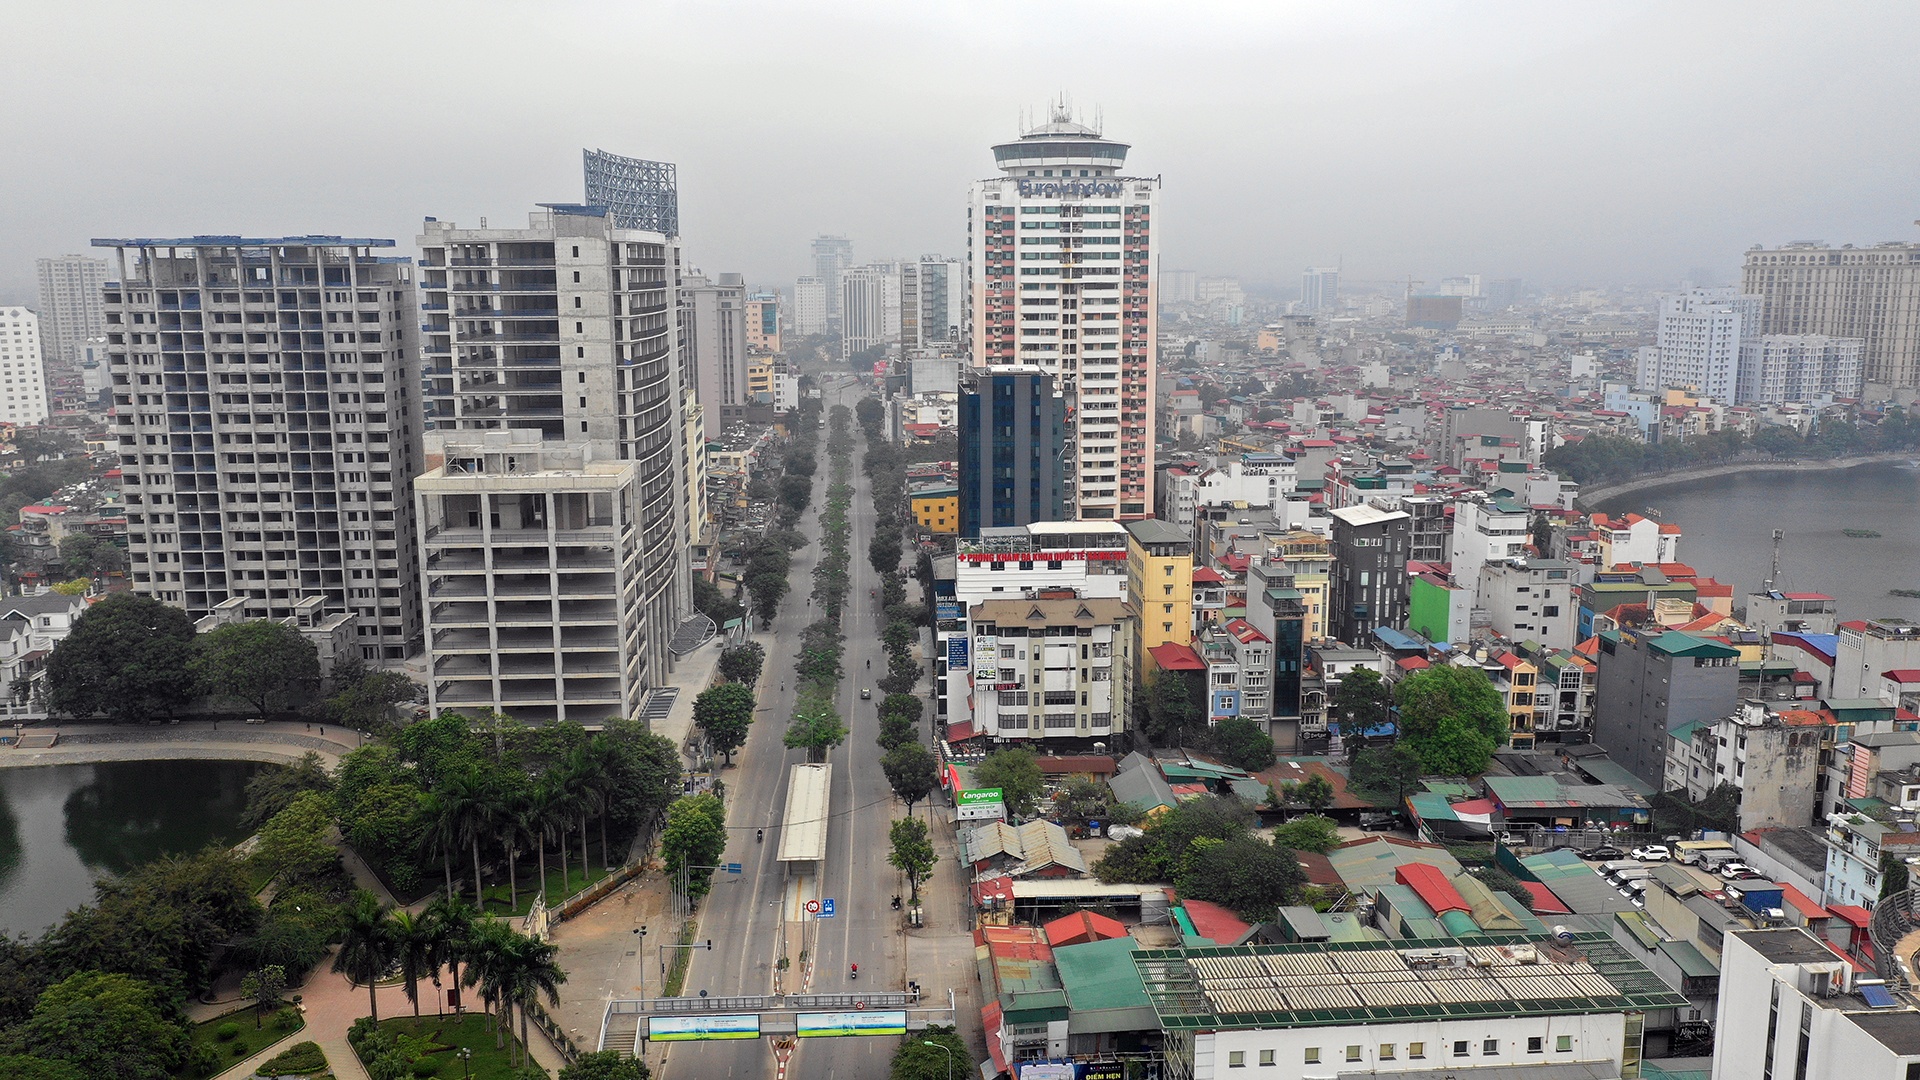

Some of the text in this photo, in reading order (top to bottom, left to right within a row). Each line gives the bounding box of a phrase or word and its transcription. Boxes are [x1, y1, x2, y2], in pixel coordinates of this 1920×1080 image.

[1020, 180, 1121, 196] Eurowindow
[967, 552, 994, 562] PHÒNG
[996, 552, 1021, 562] KHÁM
[1021, 552, 1031, 561] ĐA
[1033, 552, 1053, 561] KHOA
[1054, 549, 1075, 561] QUỐC
[1076, 549, 1086, 561] TẾ
[961, 791, 999, 800] Kangaroo
